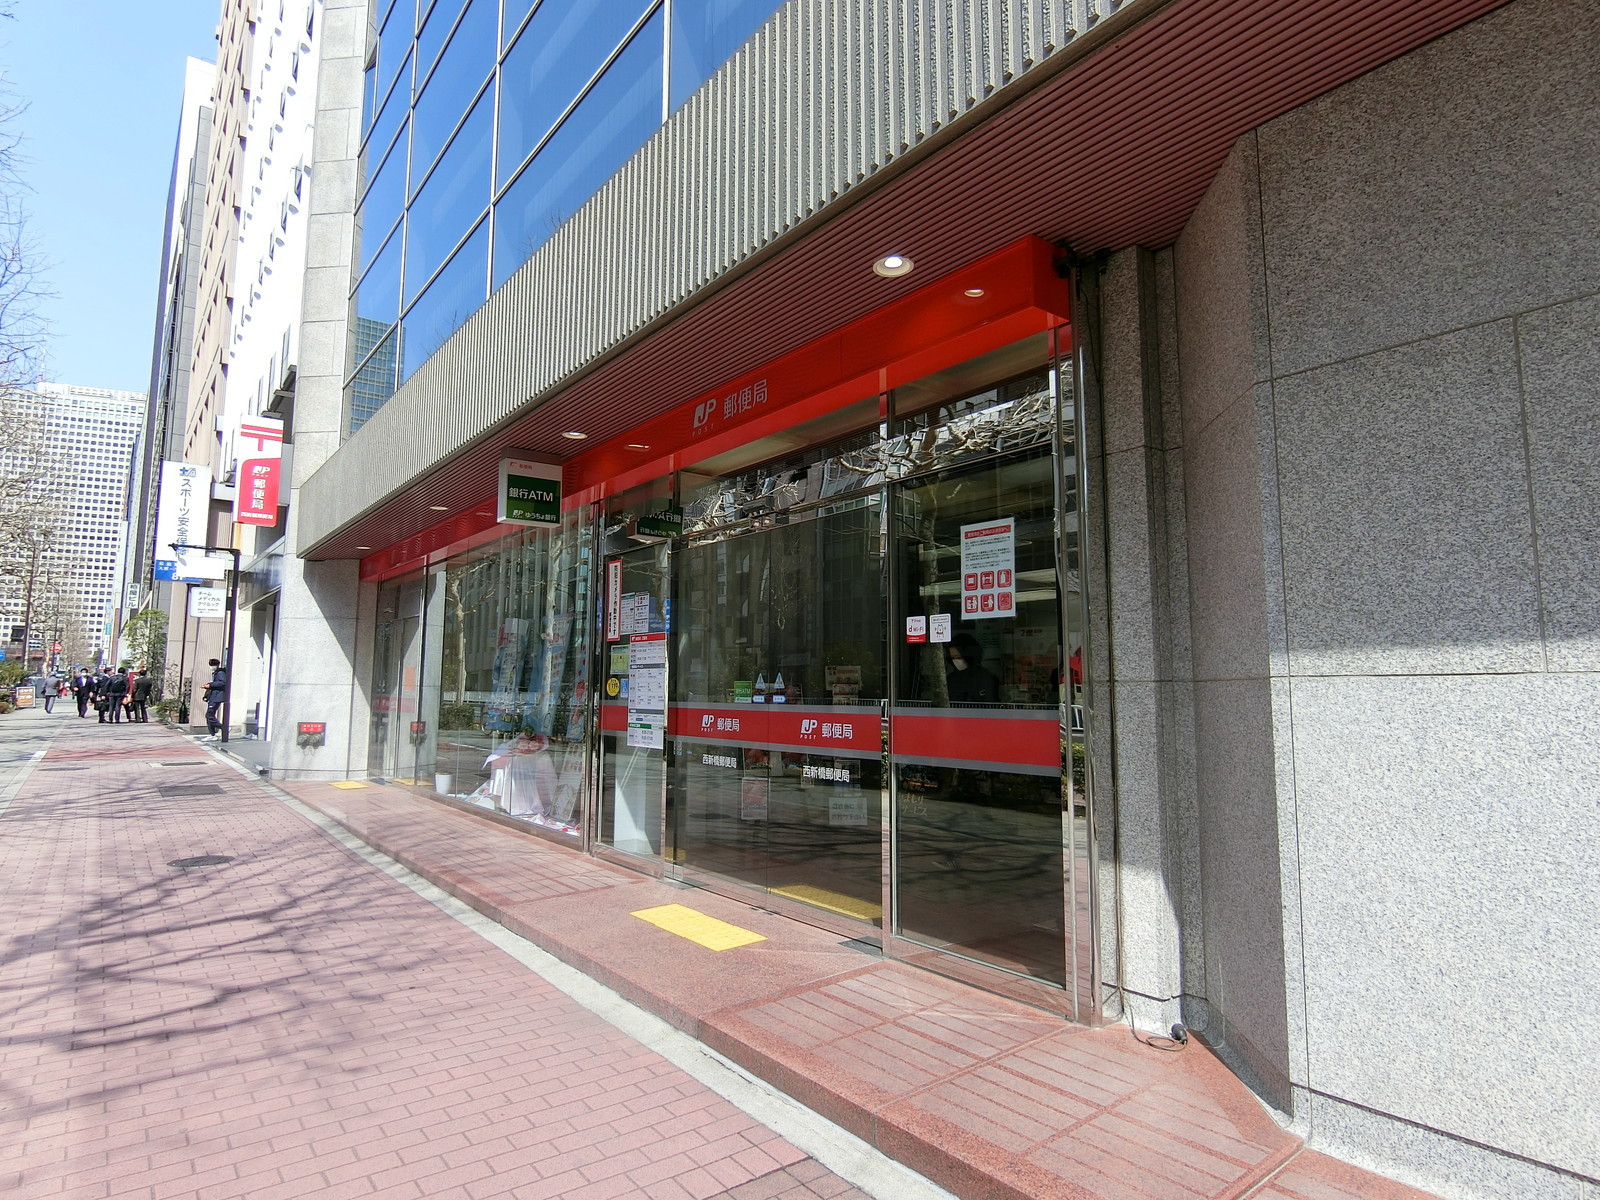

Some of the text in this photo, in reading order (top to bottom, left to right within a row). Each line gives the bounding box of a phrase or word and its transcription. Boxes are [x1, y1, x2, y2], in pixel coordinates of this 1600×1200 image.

[723, 379, 768, 420] 郵便局
[251, 478, 266, 510] 郵便局
[508, 487, 554, 502] 銀行ATM
[525, 512, 557, 521] ゆうちょ銀行
[716, 717, 740, 732] 郵便局
[821, 723, 853, 740] 郵便局
[702, 753, 737, 769] 西新橋郵便局
[802, 765, 850, 783] 西新橋郵便局
